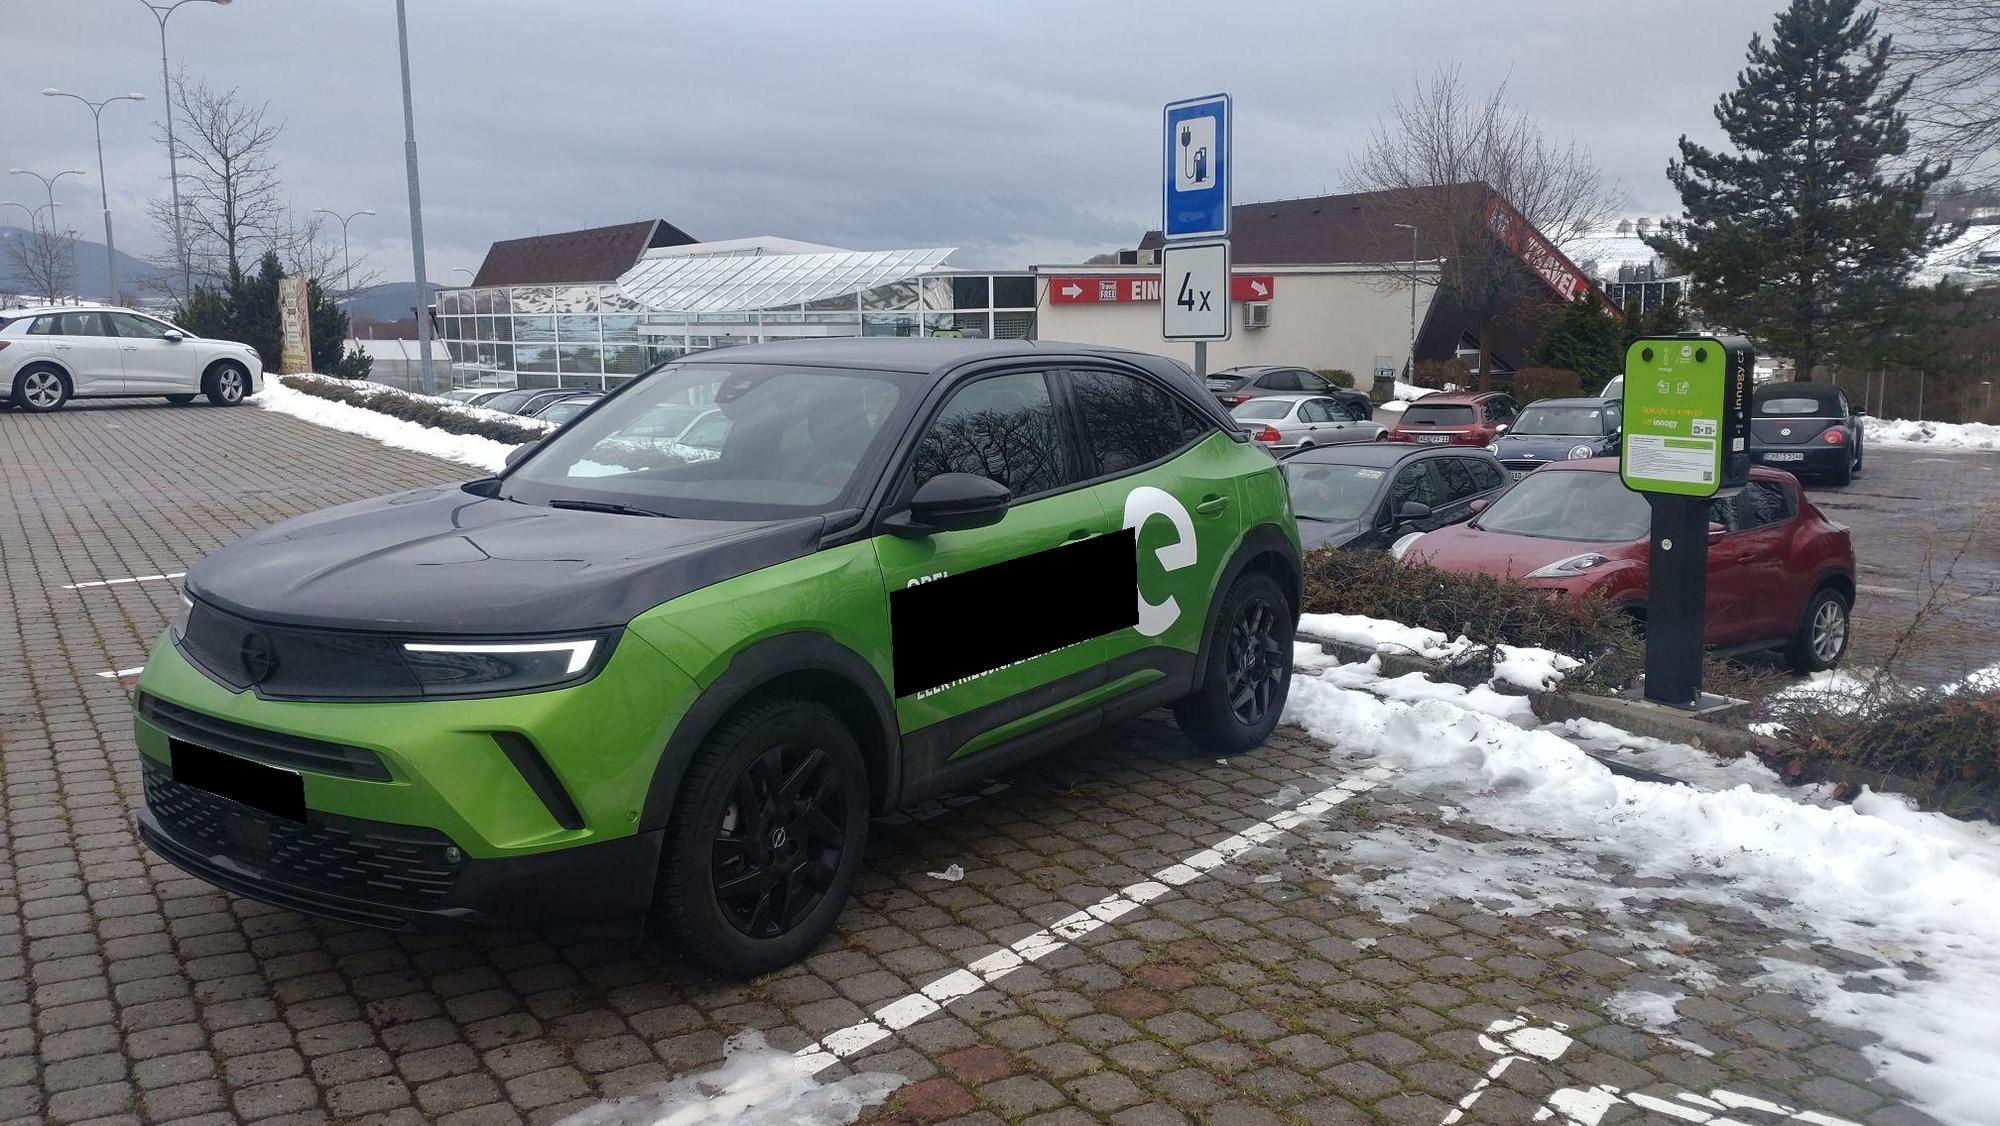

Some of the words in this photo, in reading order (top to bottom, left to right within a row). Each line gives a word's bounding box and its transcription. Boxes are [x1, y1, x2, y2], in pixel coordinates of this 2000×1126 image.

[1524, 236, 1575, 302] TRAVEL
[1100, 290, 1116, 299] FREE
[1131, 281, 1162, 300] EIN
[1653, 418, 1679, 429] innogy
